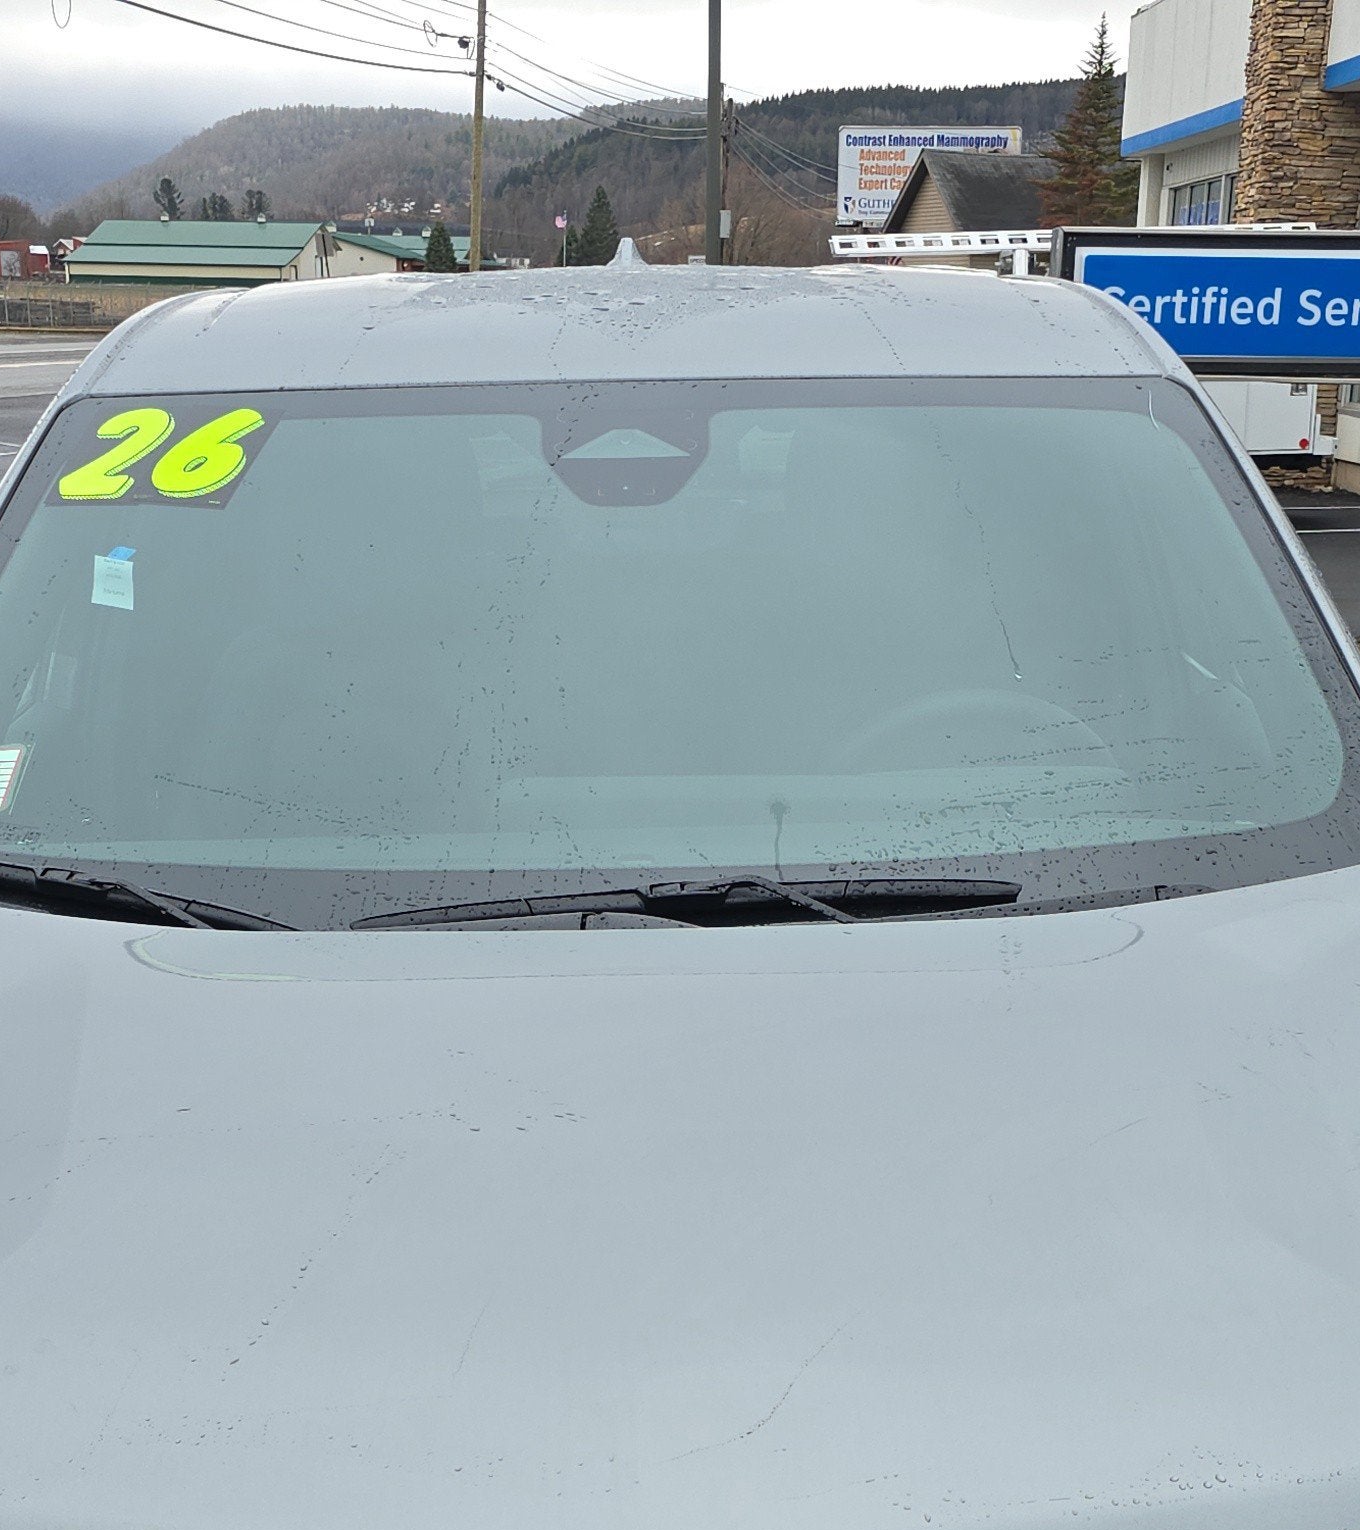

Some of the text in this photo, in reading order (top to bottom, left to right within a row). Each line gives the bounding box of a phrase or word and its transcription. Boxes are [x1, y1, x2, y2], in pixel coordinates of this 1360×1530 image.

[846, 134, 1009, 149] Contrast Enhanced Mammography
[859, 149, 905, 161] Advanced
[859, 178, 887, 190] Expert
[59, 408, 266, 500] 26
